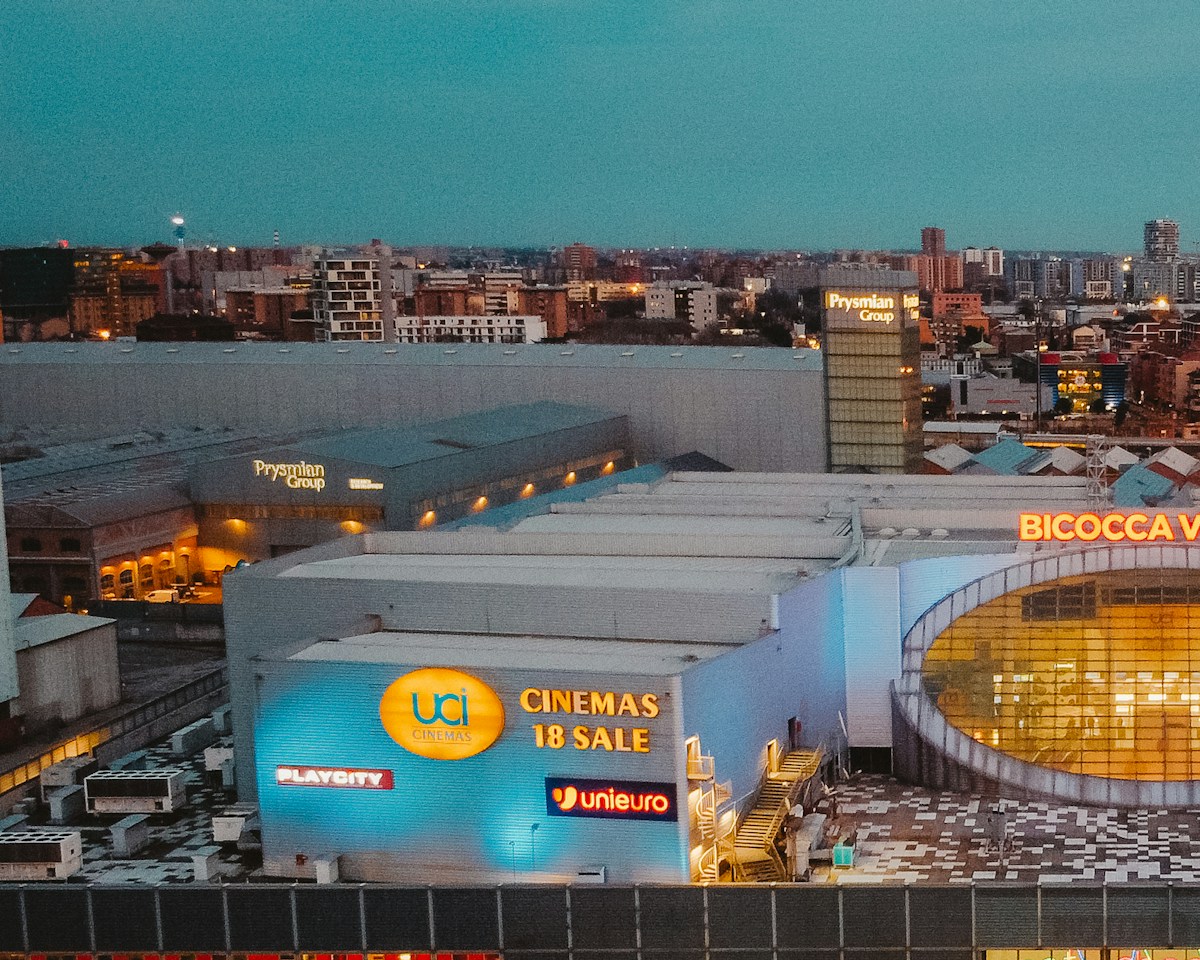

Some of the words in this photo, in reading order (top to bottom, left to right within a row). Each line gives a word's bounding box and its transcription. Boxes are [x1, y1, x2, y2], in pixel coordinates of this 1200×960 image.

[829, 294, 894, 312] Prysmian
[860, 310, 894, 324] Group
[254, 460, 325, 481] Prysmian
[287, 475, 325, 492] Group
[1019, 512, 1174, 542] BICOCCA
[519, 687, 661, 719] CINEMAS
[412, 729, 473, 743] CINEMAS
[533, 723, 564, 750] 18
[573, 725, 651, 753] SALE
[277, 768, 383, 786] PLAYCITY
[580, 786, 670, 814] unieuro
